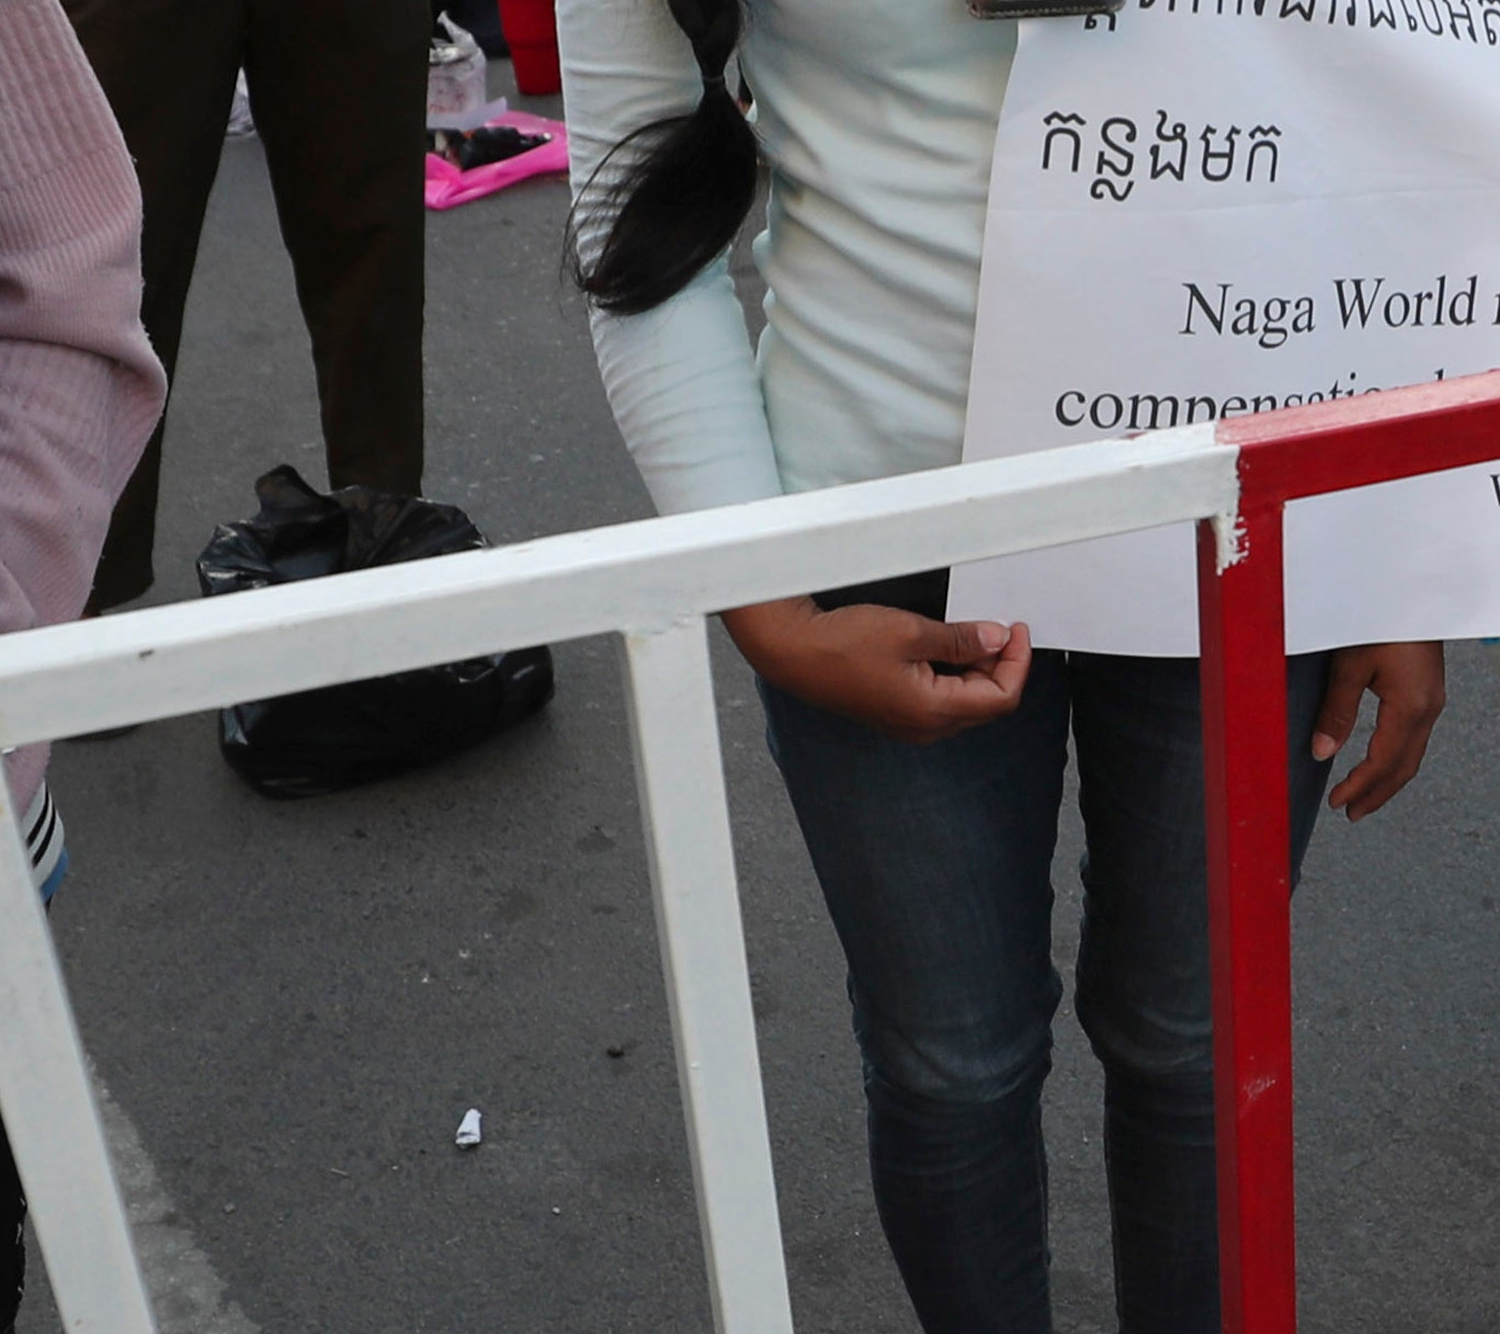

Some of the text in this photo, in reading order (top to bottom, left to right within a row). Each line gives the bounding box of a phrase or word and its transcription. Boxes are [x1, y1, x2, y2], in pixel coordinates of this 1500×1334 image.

[1042, 109, 1283, 202] កន្លងមក
[1177, 281, 1317, 349] Naga
[1332, 274, 1479, 330] World
